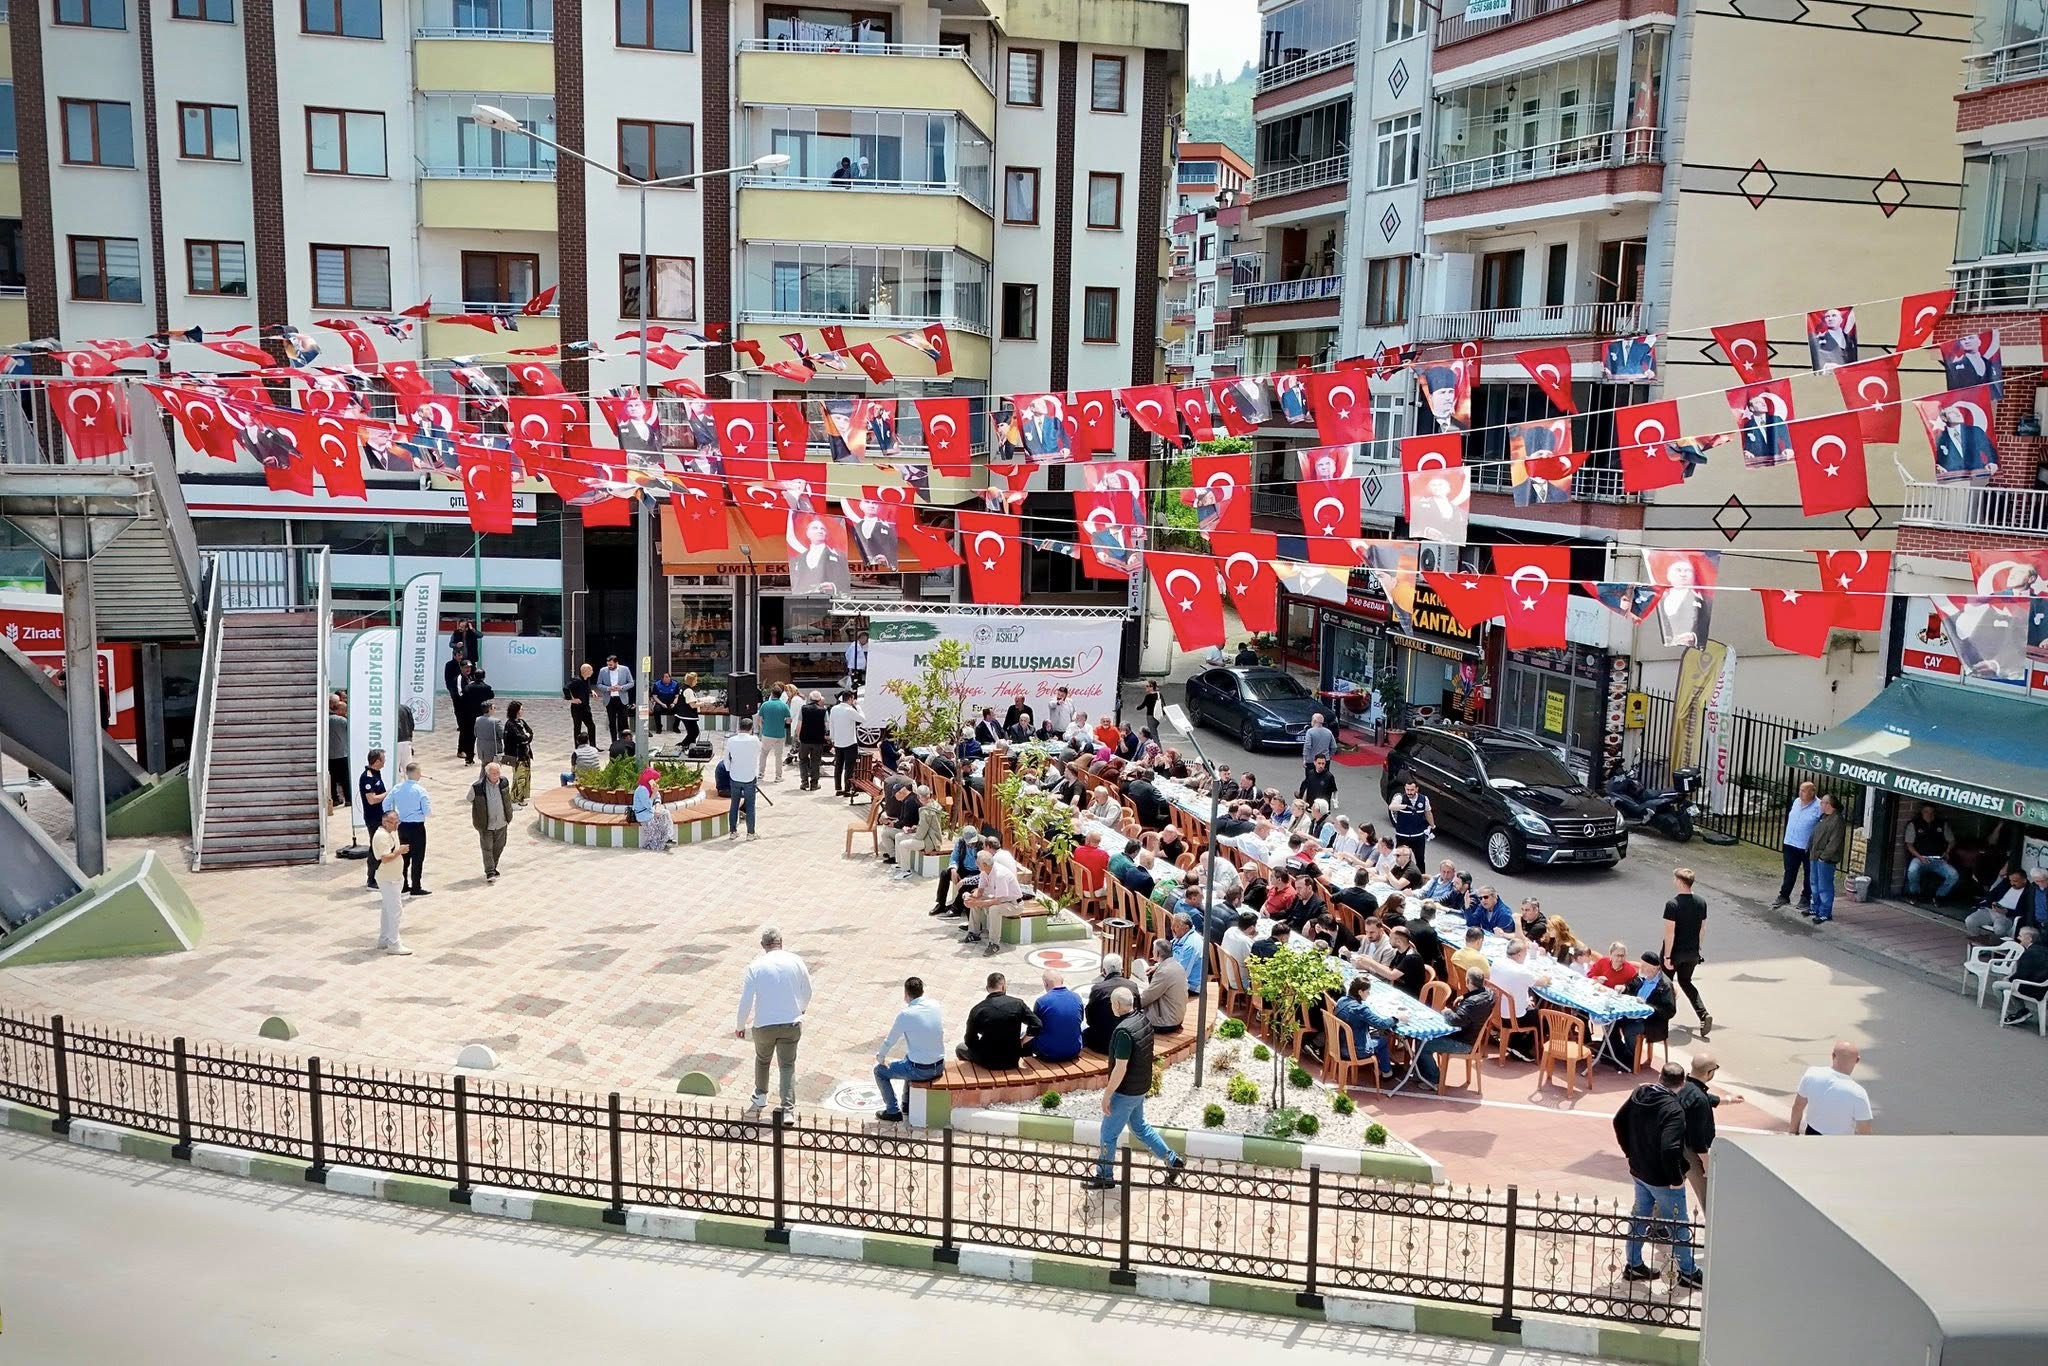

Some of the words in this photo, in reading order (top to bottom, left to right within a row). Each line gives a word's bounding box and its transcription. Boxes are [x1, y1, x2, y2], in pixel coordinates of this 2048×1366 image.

[414, 585, 429, 643] BELEDİYESİ
[1392, 608, 1472, 639] LKANTASI
[22, 627, 61, 639] Ziraat
[410, 647, 426, 693] GİRESUN
[913, 654, 986, 669] MLLE
[991, 655, 1075, 672] BULUŞMASI
[1923, 655, 1942, 669] ÇAY
[365, 641, 383, 717] BELEDİYESİ
[1838, 762, 1888, 785] DURAK
